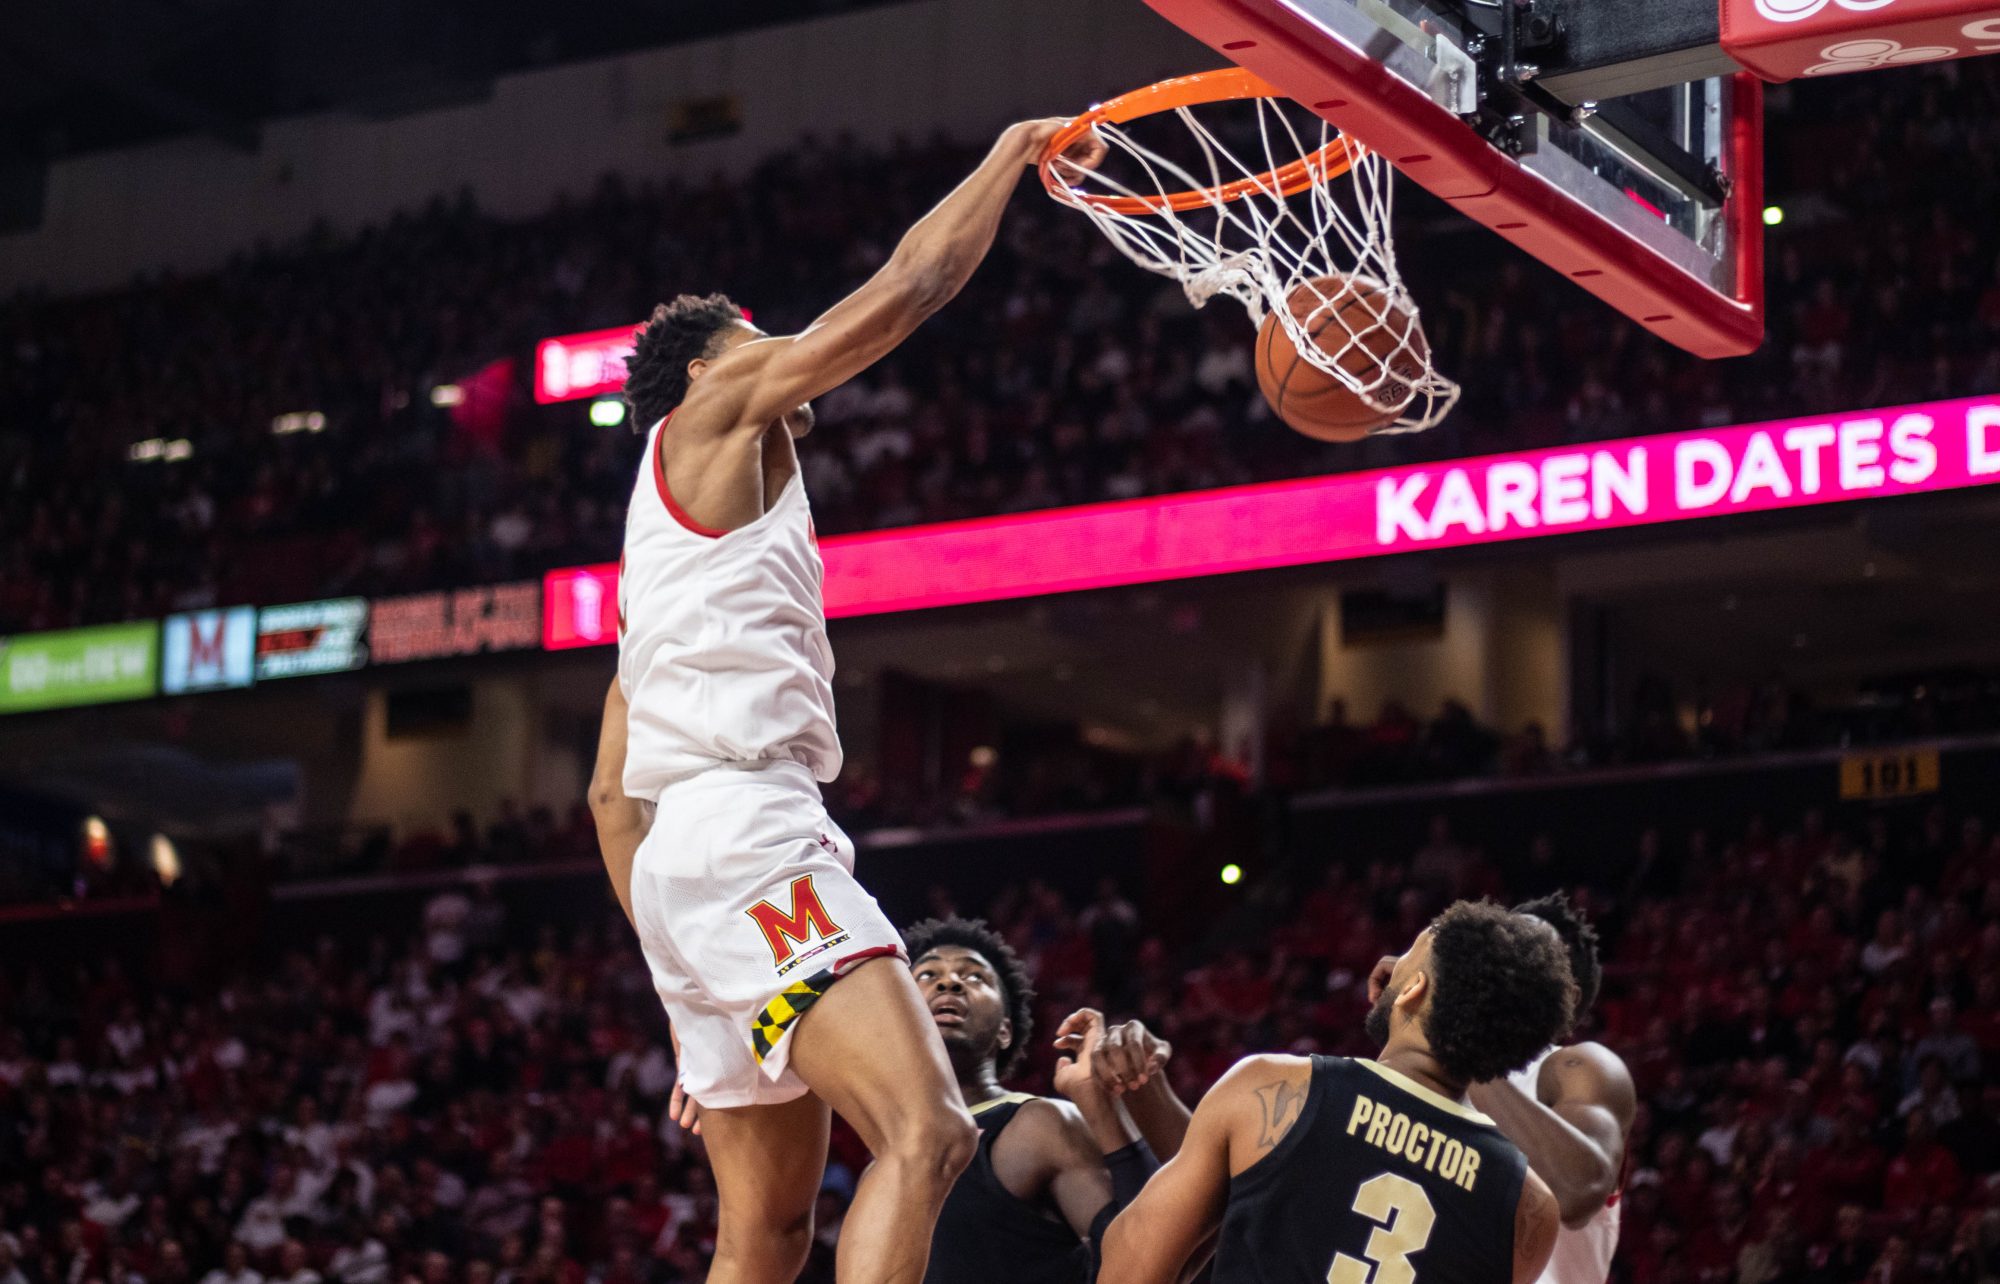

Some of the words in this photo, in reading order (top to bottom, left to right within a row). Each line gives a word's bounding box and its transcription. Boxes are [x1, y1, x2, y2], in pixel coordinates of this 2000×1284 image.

[1374, 446, 1648, 544] KAREN
[1674, 413, 1938, 508] DATES
[1863, 758, 1916, 791] 101
[745, 874, 844, 967] M
[1346, 1094, 1482, 1192] PROCTOR
[1326, 1172, 1437, 1284] 3
